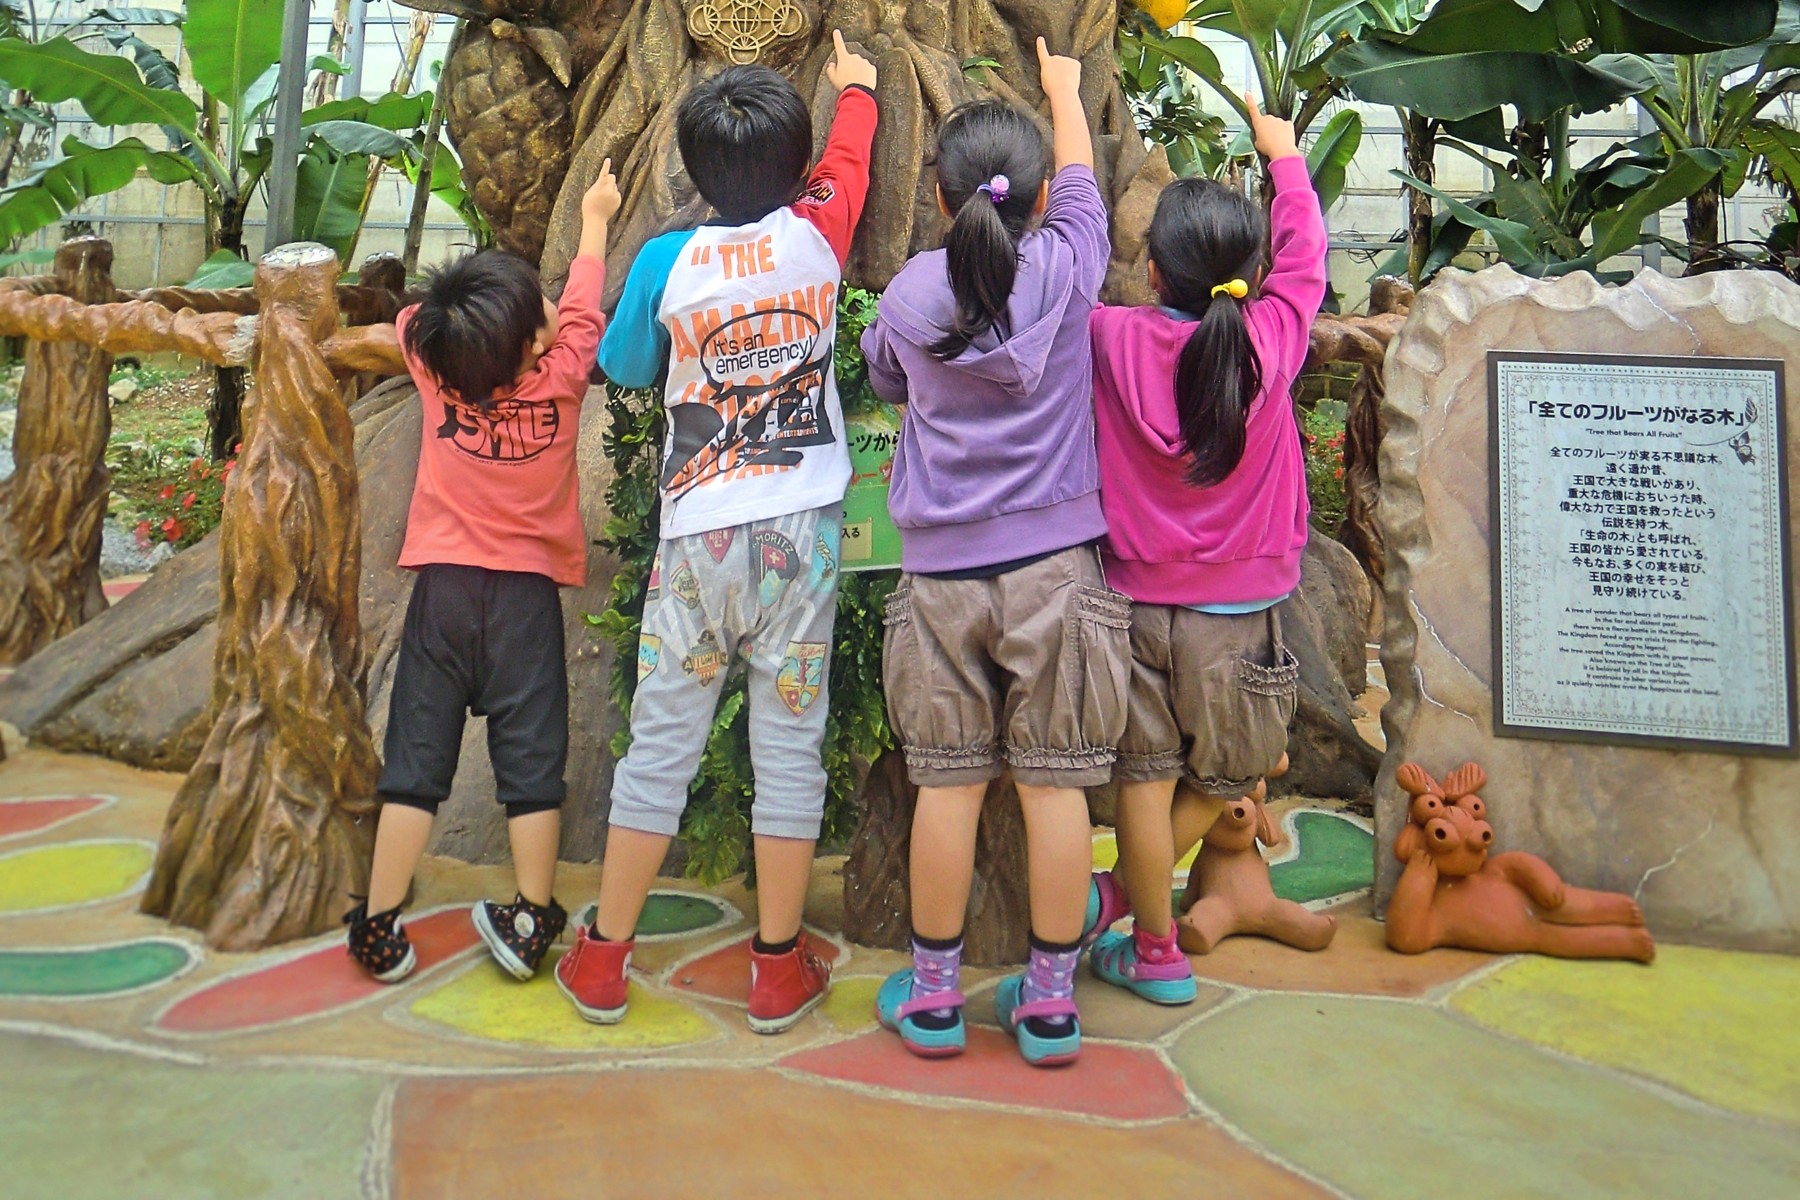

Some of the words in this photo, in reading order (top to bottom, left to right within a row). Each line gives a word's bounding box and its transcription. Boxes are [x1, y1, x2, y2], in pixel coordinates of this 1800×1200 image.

[670, 281, 836, 362] AMAZING
[713, 335, 740, 357] It's
[743, 332, 764, 352] an
[715, 335, 814, 375] emergency!
[1528, 400, 1747, 427] 「全てのフルーツがなる木」
[1606, 428, 1621, 436] that
[1550, 446, 1723, 465] 全てのフルーツが実る不思議な木。
[1572, 475, 1701, 491] 王国で大きな戦いがあり、
[1568, 487, 1707, 506] 重大な危機におちいった時、
[1559, 501, 1716, 519] 偉大な力で王国を救ったという
[1601, 517, 1673, 532] 伝説を持つ木。
[755, 532, 794, 555] MORITZ
[1579, 529, 1698, 547] 「生命の木」とも呼ばれ、
[1569, 543, 1708, 560] 王国の皆から愛されている。
[1572, 556, 1706, 575] 今もなお、多くの実を結び、
[1589, 571, 1690, 588] 王国の幸せをそっと
[1592, 585, 1686, 601] 見守り続けている。
